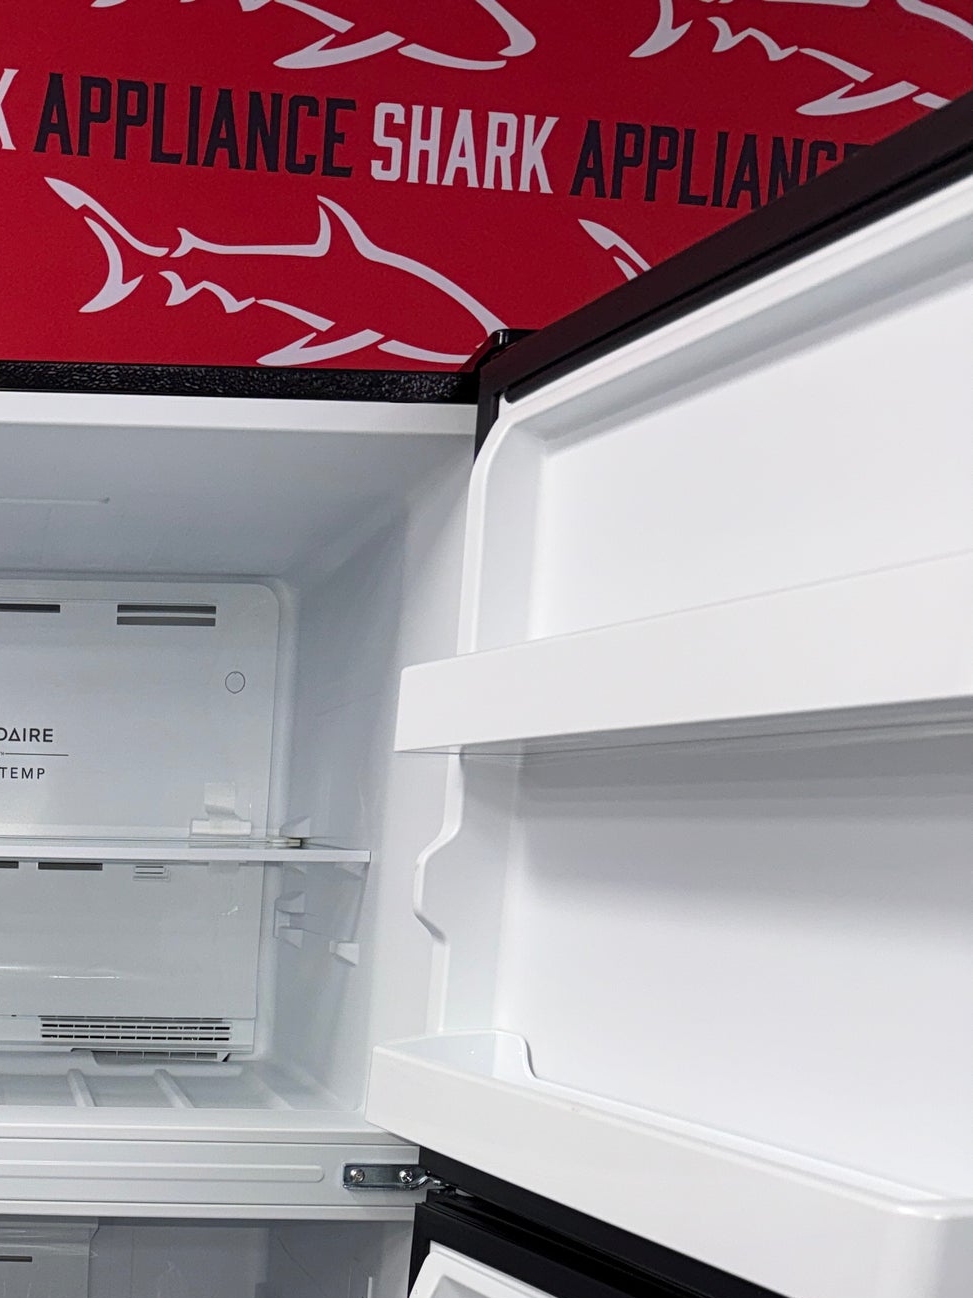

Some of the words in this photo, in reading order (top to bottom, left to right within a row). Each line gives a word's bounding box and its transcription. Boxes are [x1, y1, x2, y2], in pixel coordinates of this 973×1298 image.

[33, 72, 356, 177] APPLIANCE
[371, 101, 559, 194] SHARK
[569, 119, 873, 210] APPLIANC
